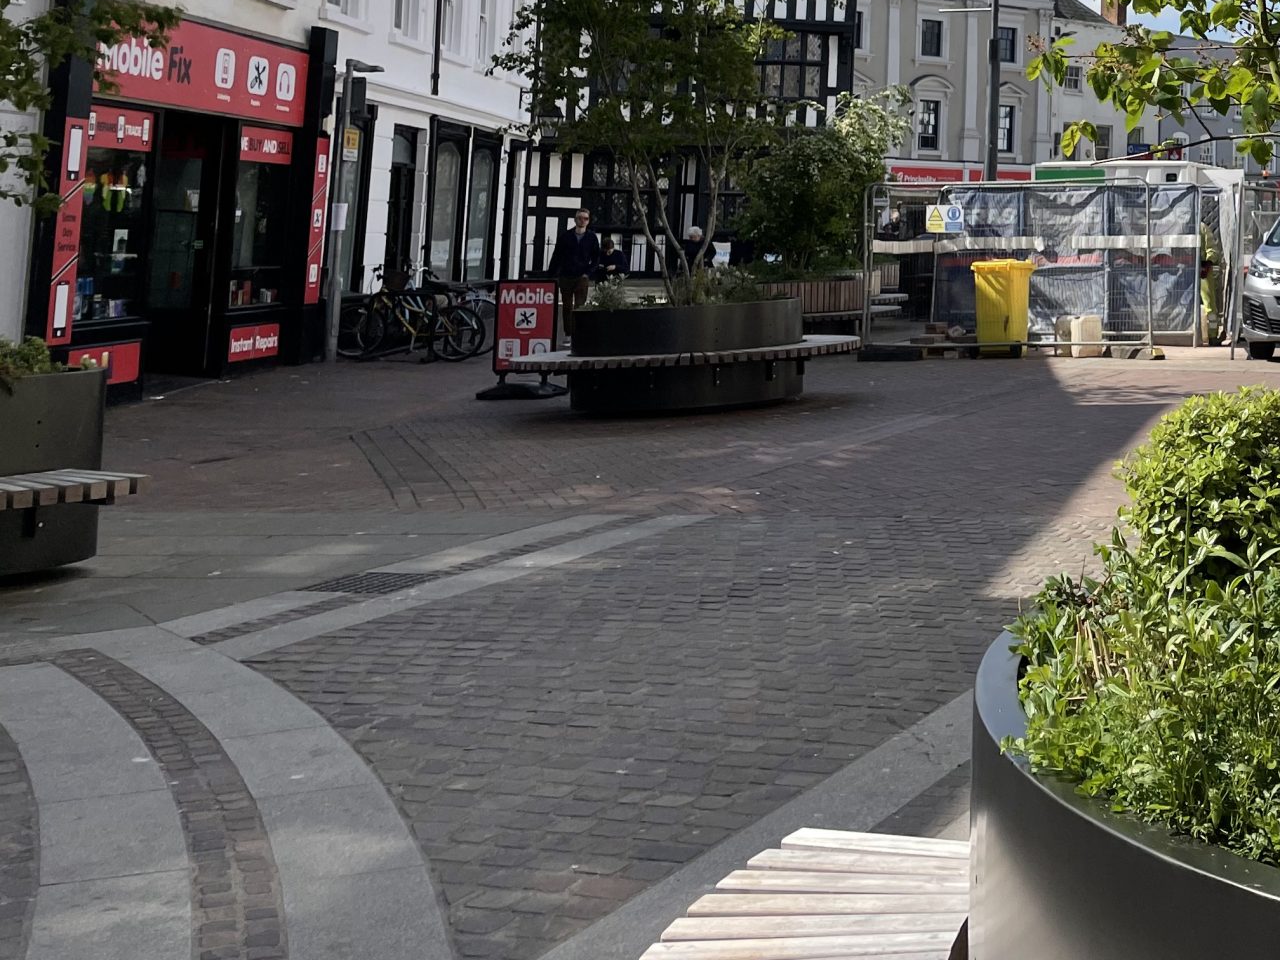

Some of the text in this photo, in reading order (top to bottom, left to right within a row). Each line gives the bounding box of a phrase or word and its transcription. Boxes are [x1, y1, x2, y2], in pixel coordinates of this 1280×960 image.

[97, 35, 192, 86] Mobile Fix
[249, 137, 262, 152] BUY
[263, 139, 278, 154] AND
[500, 287, 555, 305] Mobile
[230, 332, 278, 353] Instant Repairs
